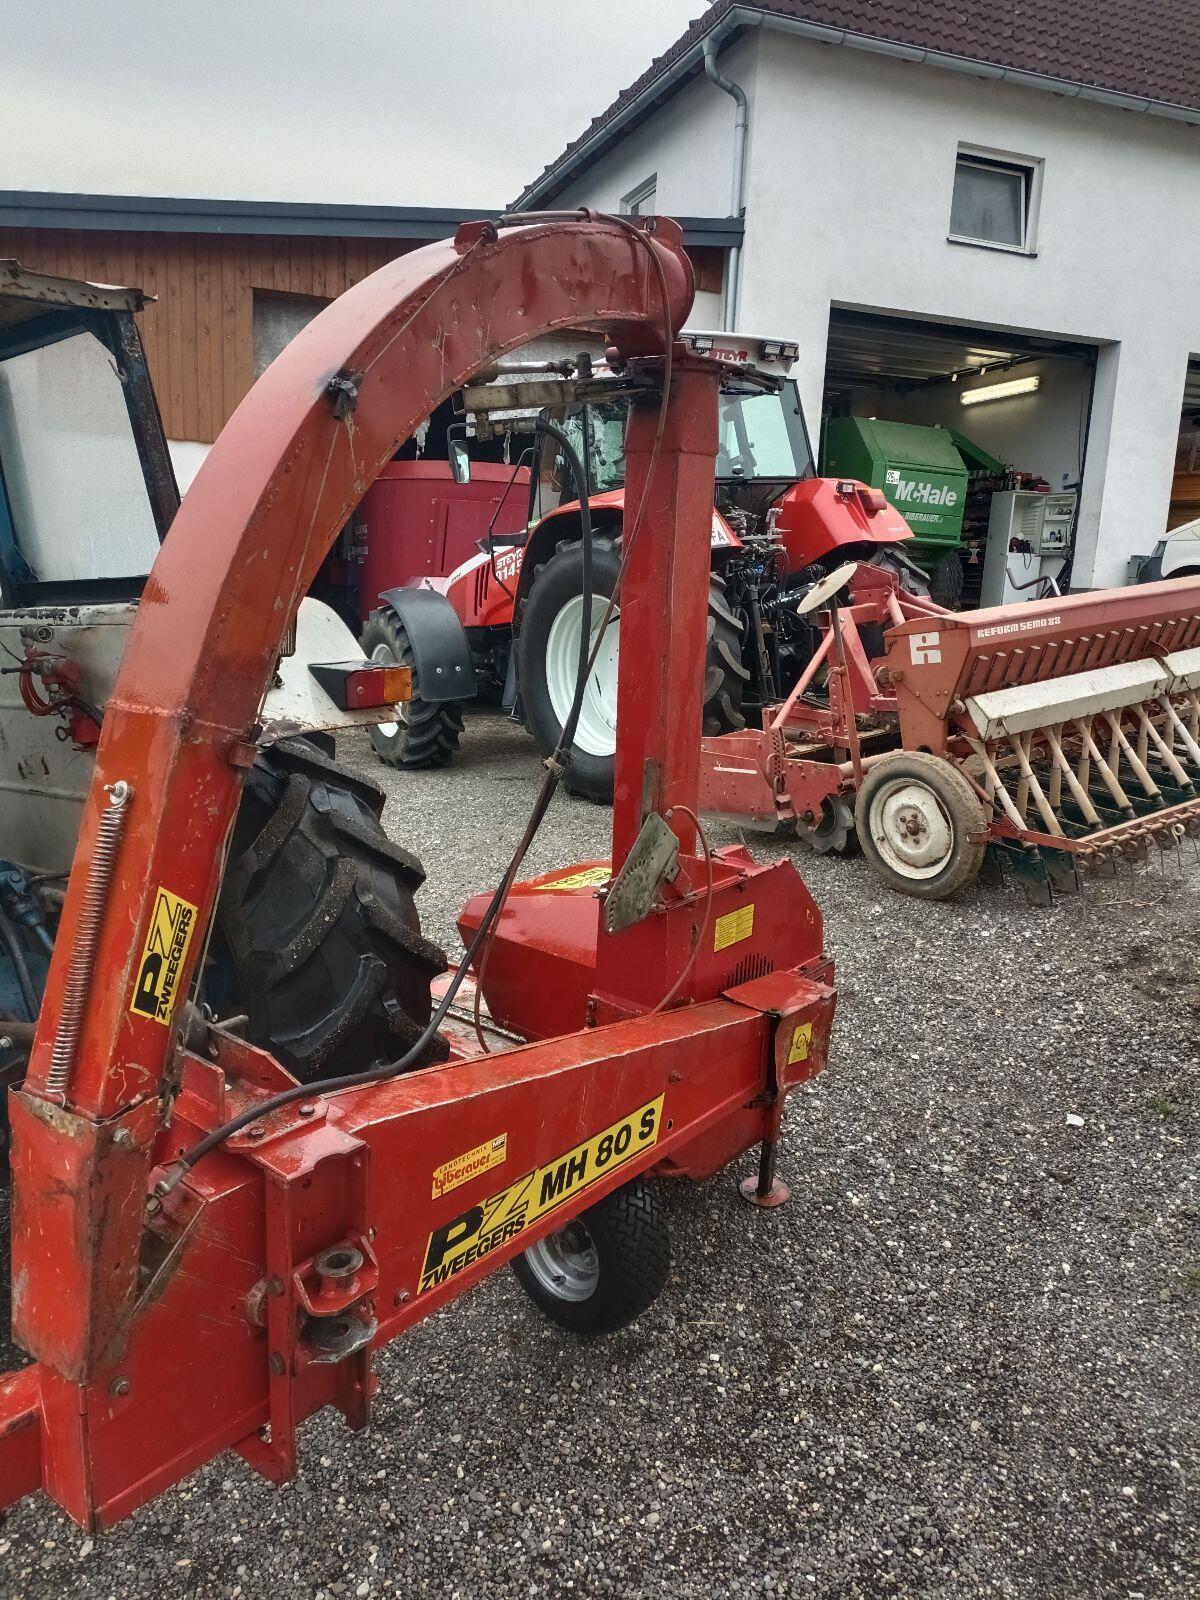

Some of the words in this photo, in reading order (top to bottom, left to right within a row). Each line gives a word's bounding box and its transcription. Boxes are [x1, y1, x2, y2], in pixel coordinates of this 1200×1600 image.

[894, 480, 957, 507] McHale
[496, 547, 523, 569] STEYR
[976, 623, 1019, 638] REFORM
[1019, 618, 1047, 631] SEMO
[1047, 616, 1062, 626] 88
[155, 906, 193, 1021] ZWEEGERS
[439, 1145, 488, 1174] LANDTECHNIK
[539, 1148, 589, 1207] MH
[595, 1124, 632, 1168] 80
[638, 1107, 656, 1141] S
[420, 1213, 526, 1292] ZWEEGERS
